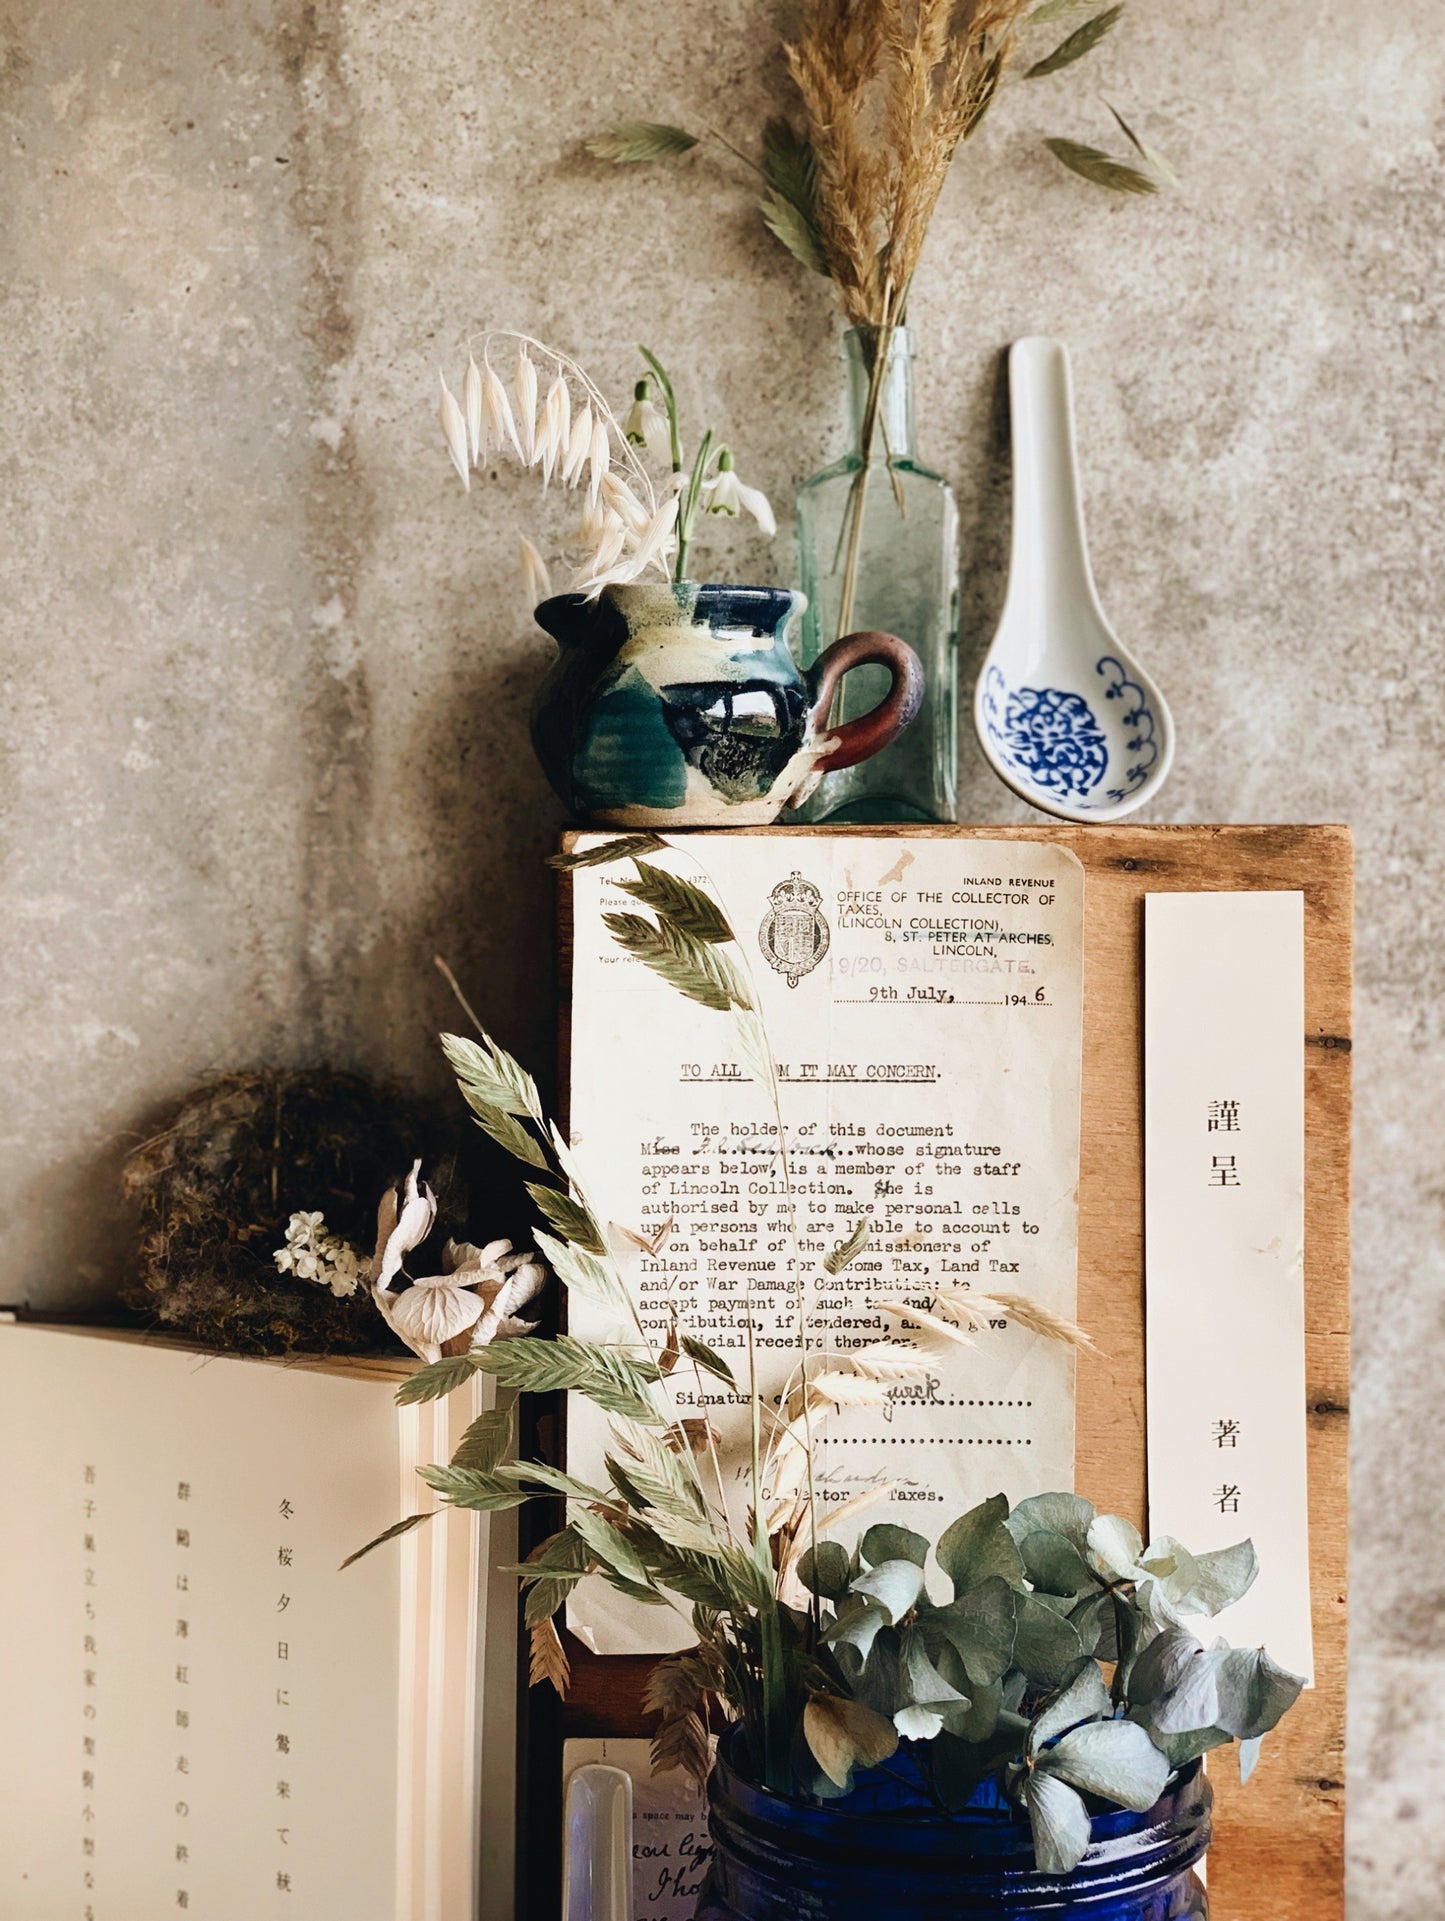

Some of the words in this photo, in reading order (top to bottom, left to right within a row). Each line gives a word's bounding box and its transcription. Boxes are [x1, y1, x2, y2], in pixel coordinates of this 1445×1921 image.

[963, 877, 1001, 886] INLAND
[1008, 878, 1055, 887] REVENUE
[836, 891, 882, 903] OFFICE
[891, 891, 908, 903] OF
[917, 891, 943, 903] THE
[951, 892, 1030, 905] COLLECTOR
[1038, 894, 1056, 905] OF
[837, 904, 883, 916] TAXES,
[837, 917, 902, 930] (LINCOLN
[909, 918, 1004, 931] COLLECTION),
[884, 932, 896, 944] 8,
[903, 932, 922, 943] ST.
[928, 932, 967, 943] PETER
[973, 933, 993, 944] AT
[998, 933, 1055, 946] ARCHES,
[932, 945, 998, 958] LINCOLN,
[828, 957, 887, 976] 19/20,
[896, 957, 1036, 975] SALTERGATE.
[869, 986, 898, 1001] 9th
[906, 986, 955, 1004] July,
[1004, 994, 1027, 1006] 194
[1034, 986, 1046, 1002] 6
[681, 1064, 702, 1077] TO
[711, 1064, 742, 1077] ALL
[800, 1064, 819, 1077] IT
[827, 1064, 858, 1078] MAY
[866, 1065, 942, 1078] CONCERN.
[690, 1122, 720, 1136] The
[730, 1122, 789, 1136] holder
[798, 1123, 818, 1136] of
[829, 1123, 866, 1137] this
[876, 1123, 954, 1137] document
[916, 1143, 1001, 1159] signature
[1207, 1099, 1242, 1188] 謹呈
[641, 1164, 710, 1178] appears
[720, 1161, 777, 1178] below,
[788, 1162, 808, 1175] is
[817, 1165, 828, 1175] a
[835, 1161, 896, 1175] member
[904, 1163, 924, 1176] of
[935, 1162, 962, 1176] the
[973, 1162, 1022, 1176] staff
[641, 1182, 661, 1195] of
[669, 1181, 740, 1195] Lincoln
[748, 1181, 853, 1196] Collection.
[914, 1181, 934, 1196] is
[641, 1200, 739, 1214] authorised
[749, 1201, 769, 1216] by
[776, 1203, 797, 1214] me
[808, 1202, 827, 1214] to
[835, 1201, 875, 1215] make
[885, 1201, 963, 1217] personal
[640, 1221, 680, 1236] upn
[690, 1222, 758, 1236] persons
[767, 1220, 796, 1233] who
[806, 1222, 835, 1233] are
[915, 1221, 933, 1233] to
[942, 1221, 1011, 1235] account
[1022, 1222, 1040, 1235] to
[669, 1242, 690, 1252] on
[699, 1238, 759, 1252] behalf
[767, 1239, 787, 1252] of
[797, 1240, 825, 1252] the
[971, 1239, 991, 1253] of
[640, 1258, 698, 1272] Inland
[707, 1259, 777, 1272] Revenue
[786, 1258, 816, 1272] for
[892, 1259, 930, 1275] Tax,
[940, 1259, 980, 1273] Land
[988, 1260, 1020, 1273] Tax
[706, 1277, 738, 1291] War
[747, 1278, 805, 1293] Damage
[952, 1278, 971, 1291] to
[639, 1297, 698, 1312] accept
[707, 1298, 776, 1312] payment
[785, 1297, 805, 1310] of
[816, 1296, 853, 1310] such
[775, 1315, 795, 1329] if
[1210, 1419, 1242, 1514] 著者
[642, 1812, 670, 1822] space
[675, 1813, 695, 1823] may
